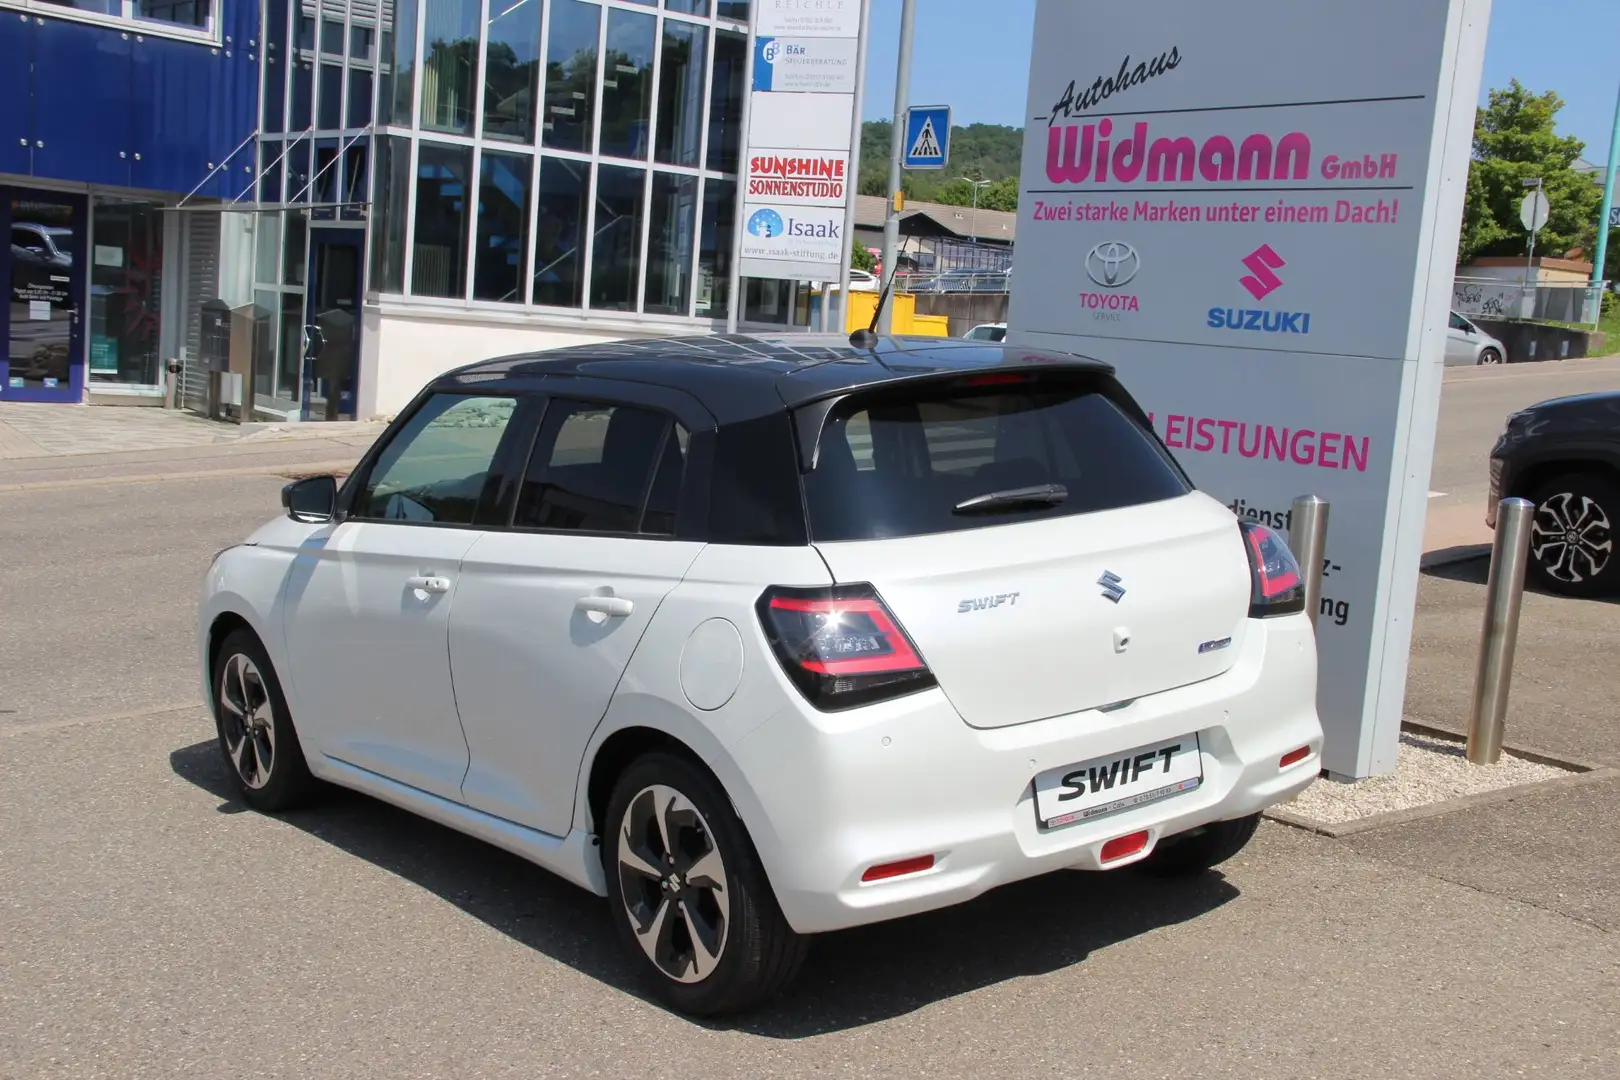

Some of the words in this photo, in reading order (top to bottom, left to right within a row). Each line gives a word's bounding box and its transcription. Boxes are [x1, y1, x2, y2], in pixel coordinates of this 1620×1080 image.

[786, 45, 806, 55] BÄR
[1048, 46, 1182, 127] Autohaus
[1046, 117, 1311, 184] Widmann
[1320, 153, 1398, 180] GmbH
[750, 155, 845, 180] SUNSHINE
[749, 180, 843, 198] SONNENSTUDIO
[1033, 201, 1073, 221] Zwei
[1076, 201, 1129, 222] starke
[1133, 201, 1201, 222] Marken
[1206, 202, 1260, 223] unter
[1265, 199, 1329, 224] einem
[1334, 199, 1399, 224] Dach!
[787, 218, 840, 239] Isaak
[744, 246, 839, 260] www.isaak-stiftung.de
[1080, 293, 1139, 311] TOYOTA
[1207, 308, 1310, 334] SUZUKI
[1149, 412, 1370, 472] EISTUNGEN
[957, 591, 1019, 613] SWIFT
[1058, 744, 1181, 801] SWIFT
